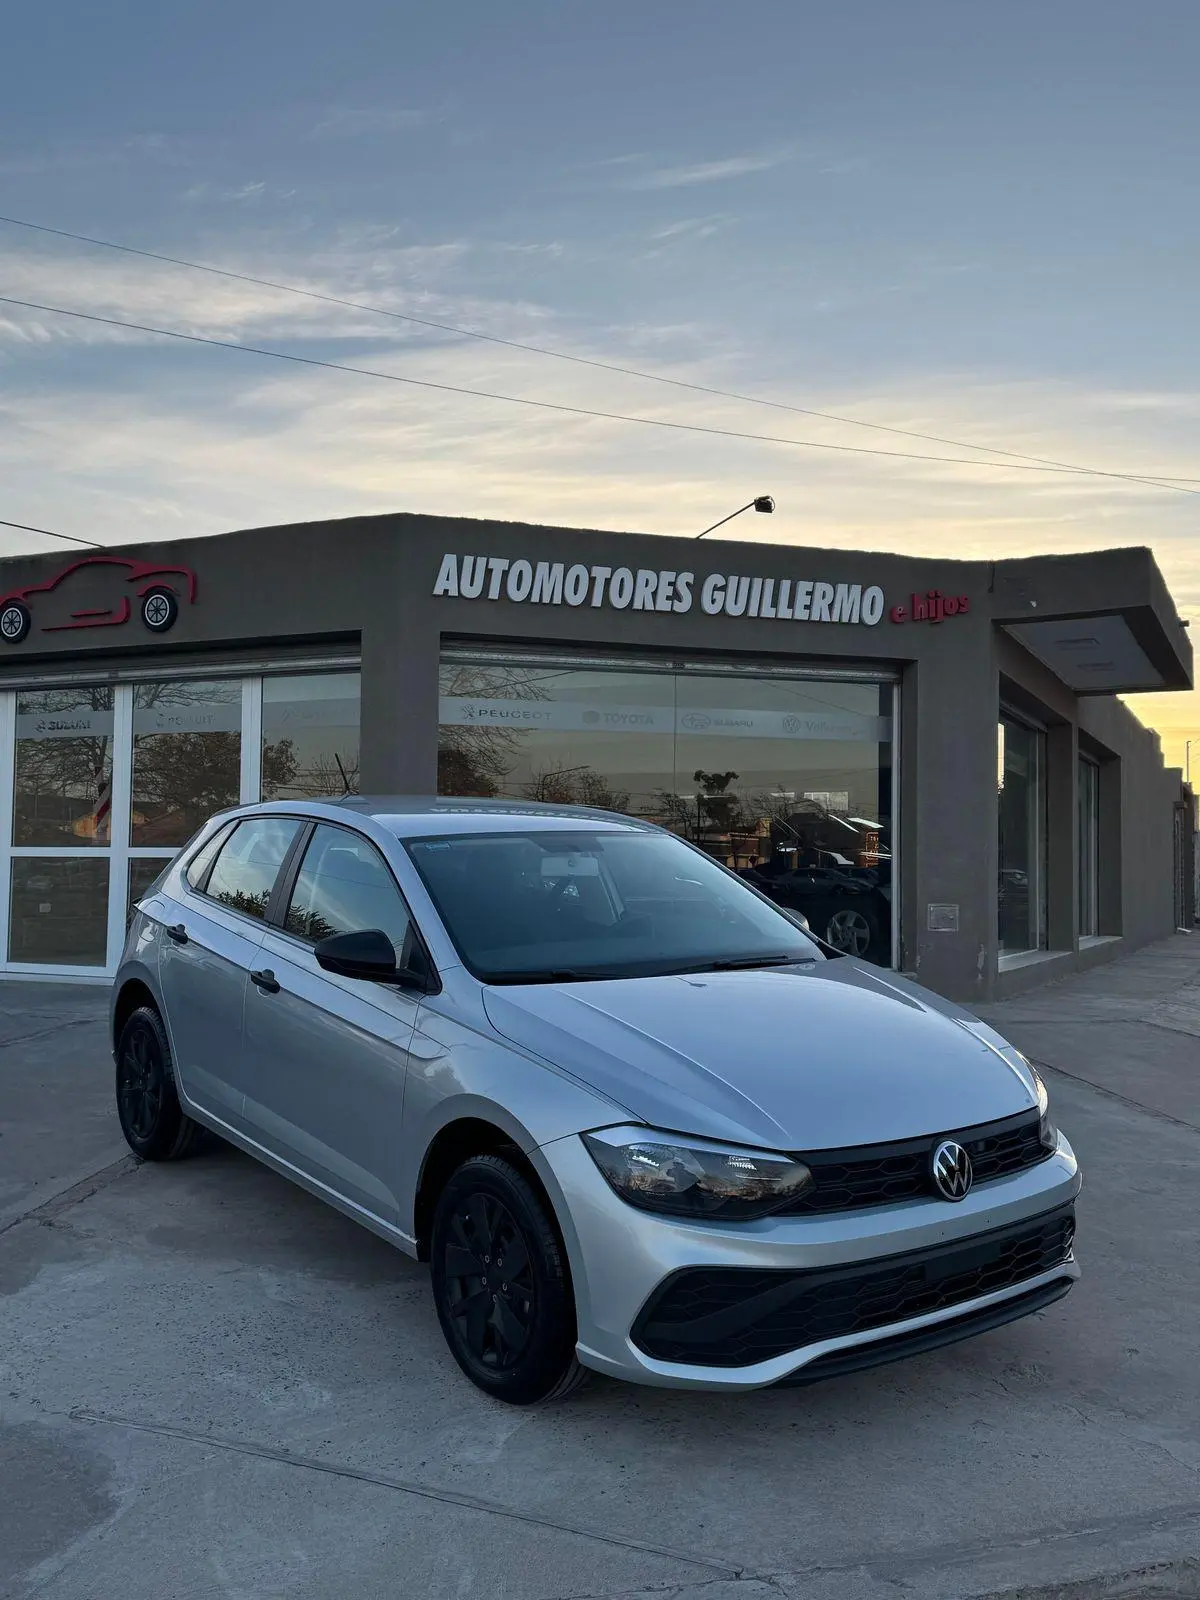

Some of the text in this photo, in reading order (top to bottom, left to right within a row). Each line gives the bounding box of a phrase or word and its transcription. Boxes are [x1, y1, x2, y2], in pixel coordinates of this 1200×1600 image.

[431, 553, 969, 626] AUTOMOTORES GUILLERMO e hijos
[478, 709, 552, 720] PEUGEOT
[603, 712, 655, 725] TOYOTA
[933, 1140, 973, 1201] VW
